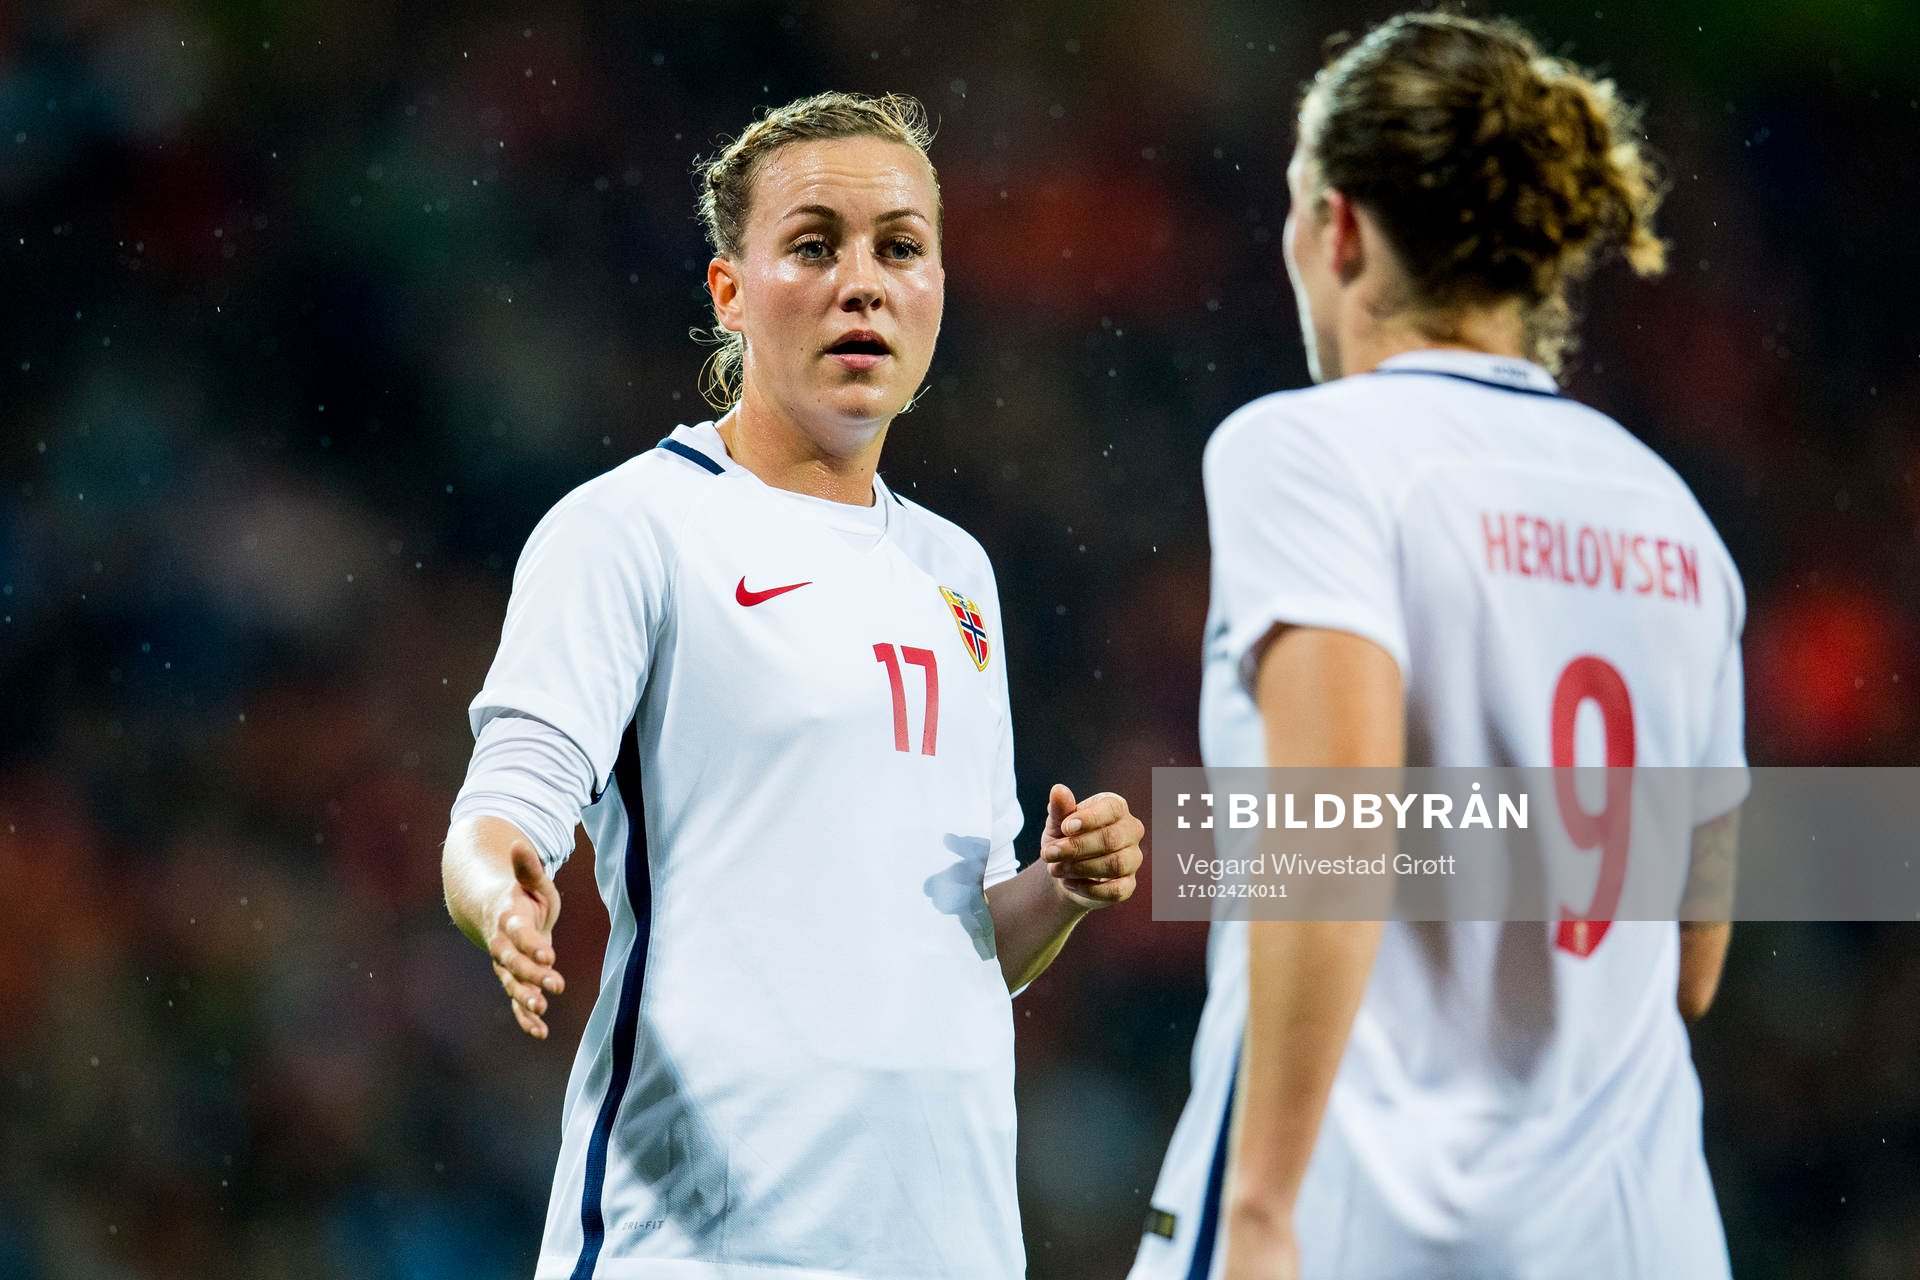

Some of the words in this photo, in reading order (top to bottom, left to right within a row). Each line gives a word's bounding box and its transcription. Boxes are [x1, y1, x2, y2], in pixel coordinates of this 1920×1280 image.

[1482, 513, 1701, 605] HERLOVSEN
[872, 643, 939, 756] 17
[1552, 656, 1635, 957] 9
